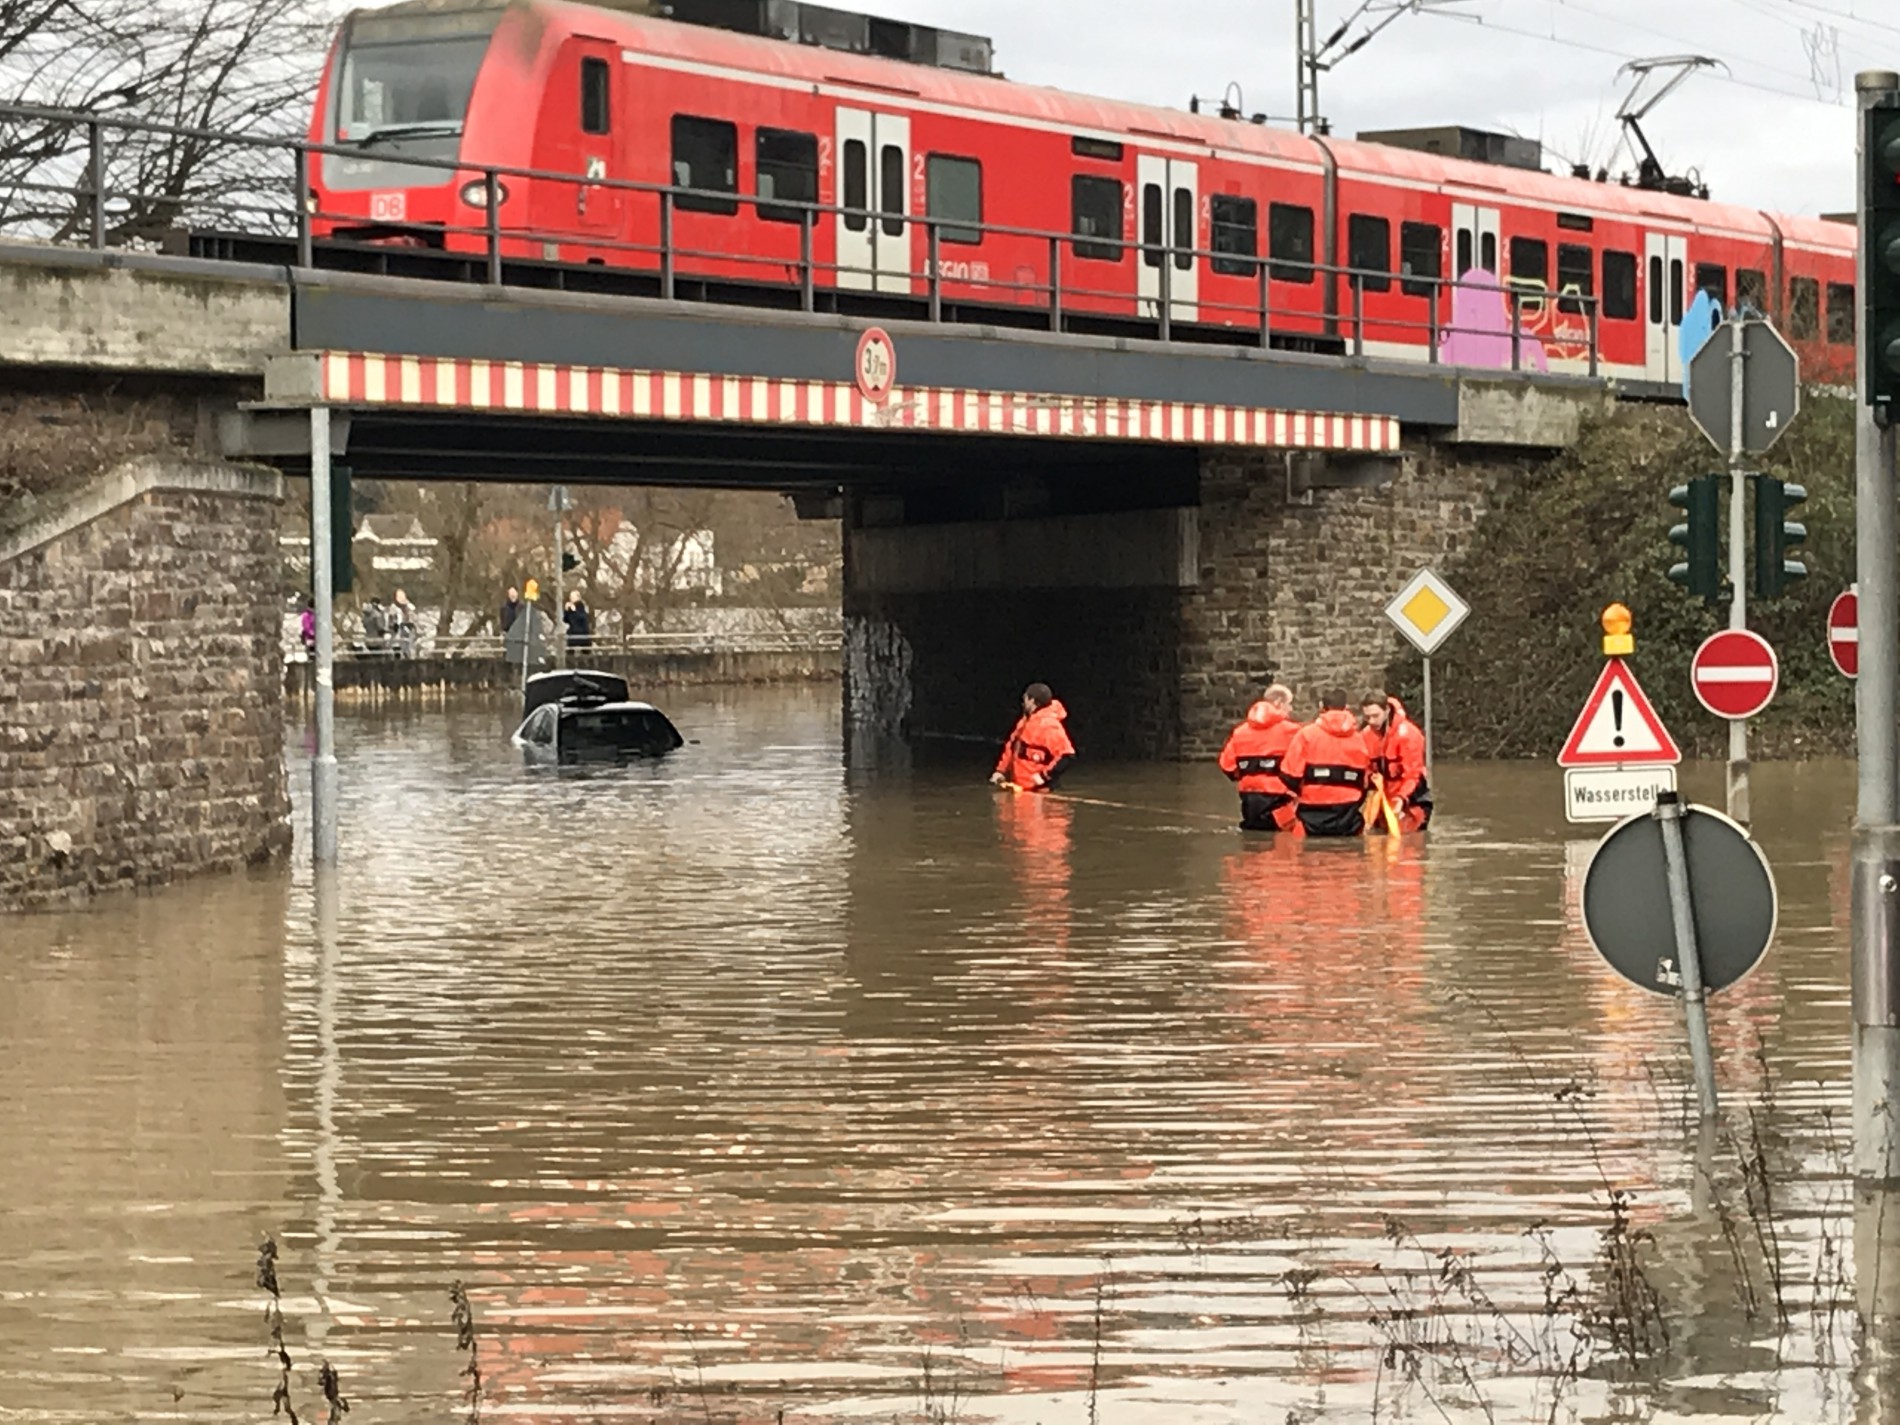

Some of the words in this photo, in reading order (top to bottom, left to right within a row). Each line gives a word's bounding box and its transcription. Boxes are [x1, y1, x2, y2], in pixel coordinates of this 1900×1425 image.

[914, 154, 925, 180] 2
[376, 197, 401, 217] DB
[1124, 184, 1133, 209] 2
